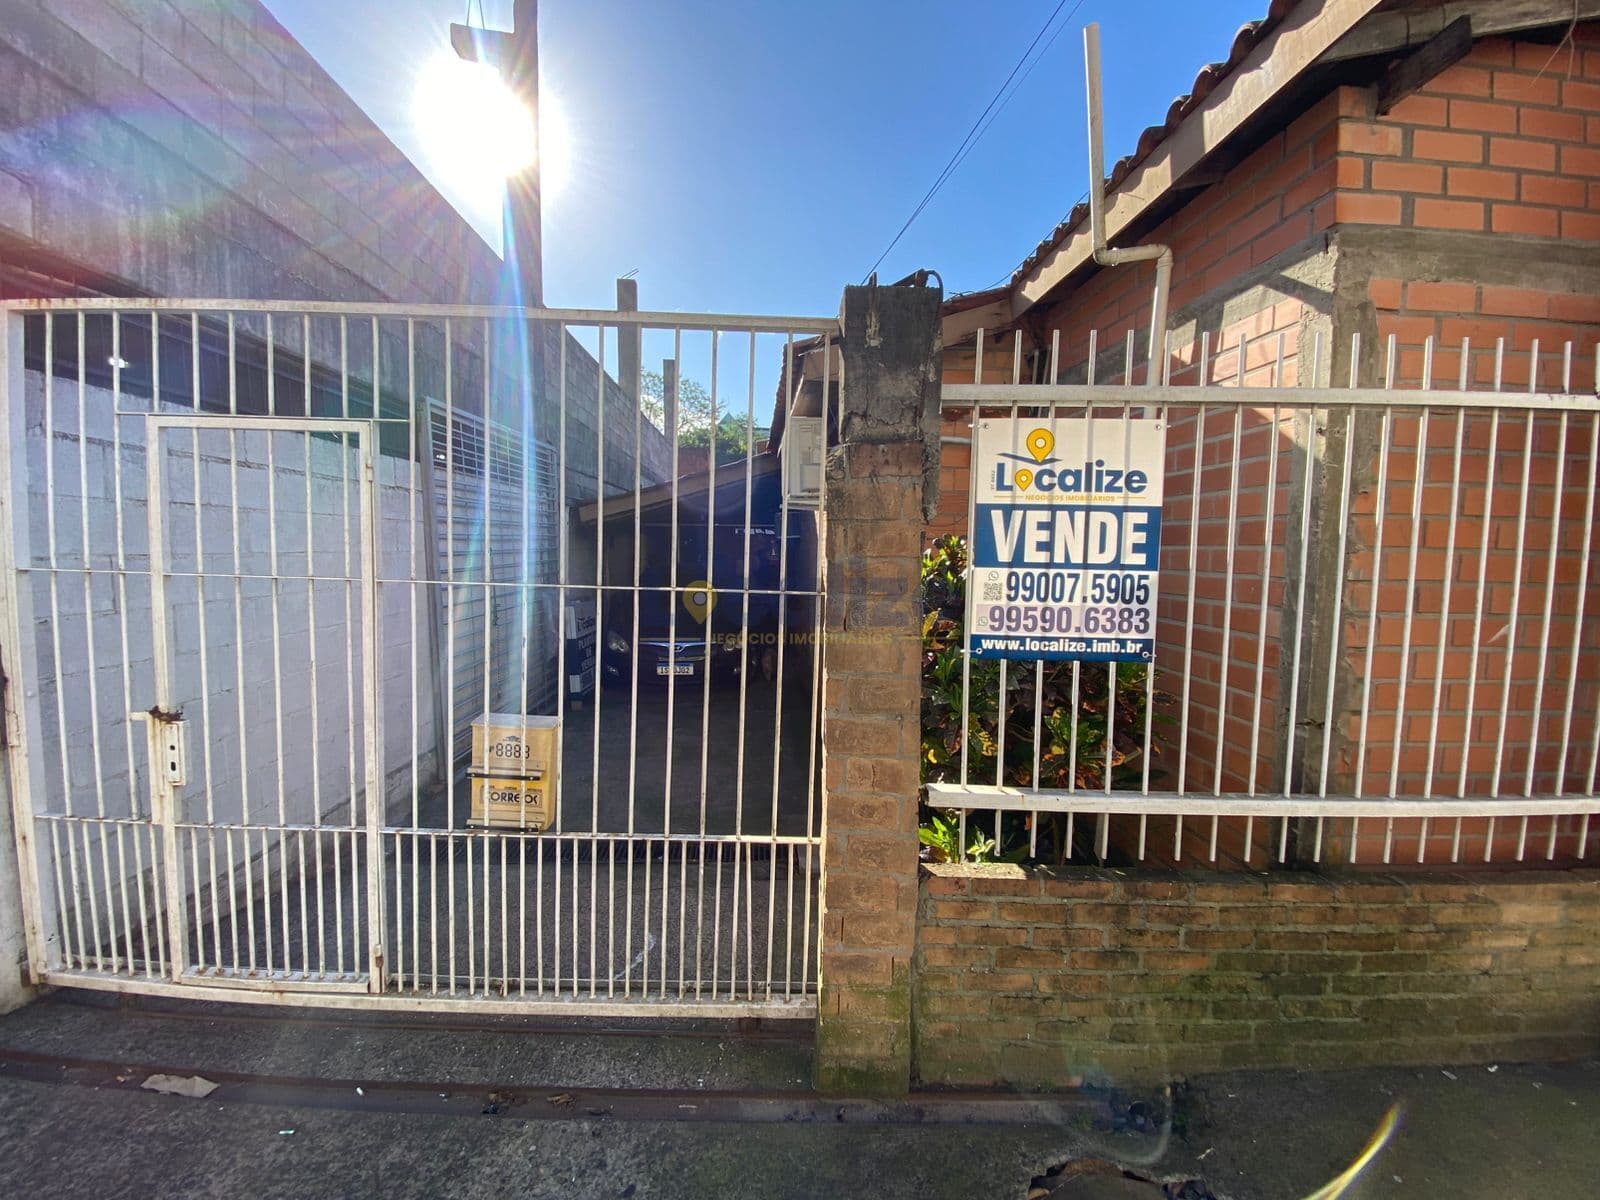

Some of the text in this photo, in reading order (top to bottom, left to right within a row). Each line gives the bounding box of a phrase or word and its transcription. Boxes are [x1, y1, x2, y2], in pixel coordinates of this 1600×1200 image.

[995, 459, 1148, 494] Localize
[990, 510, 1149, 565] VENDE
[1006, 571, 1151, 605] 99007.5905
[989, 606, 1151, 634] 99590.6383
[981, 638, 1143, 654] www.localize.imb.br
